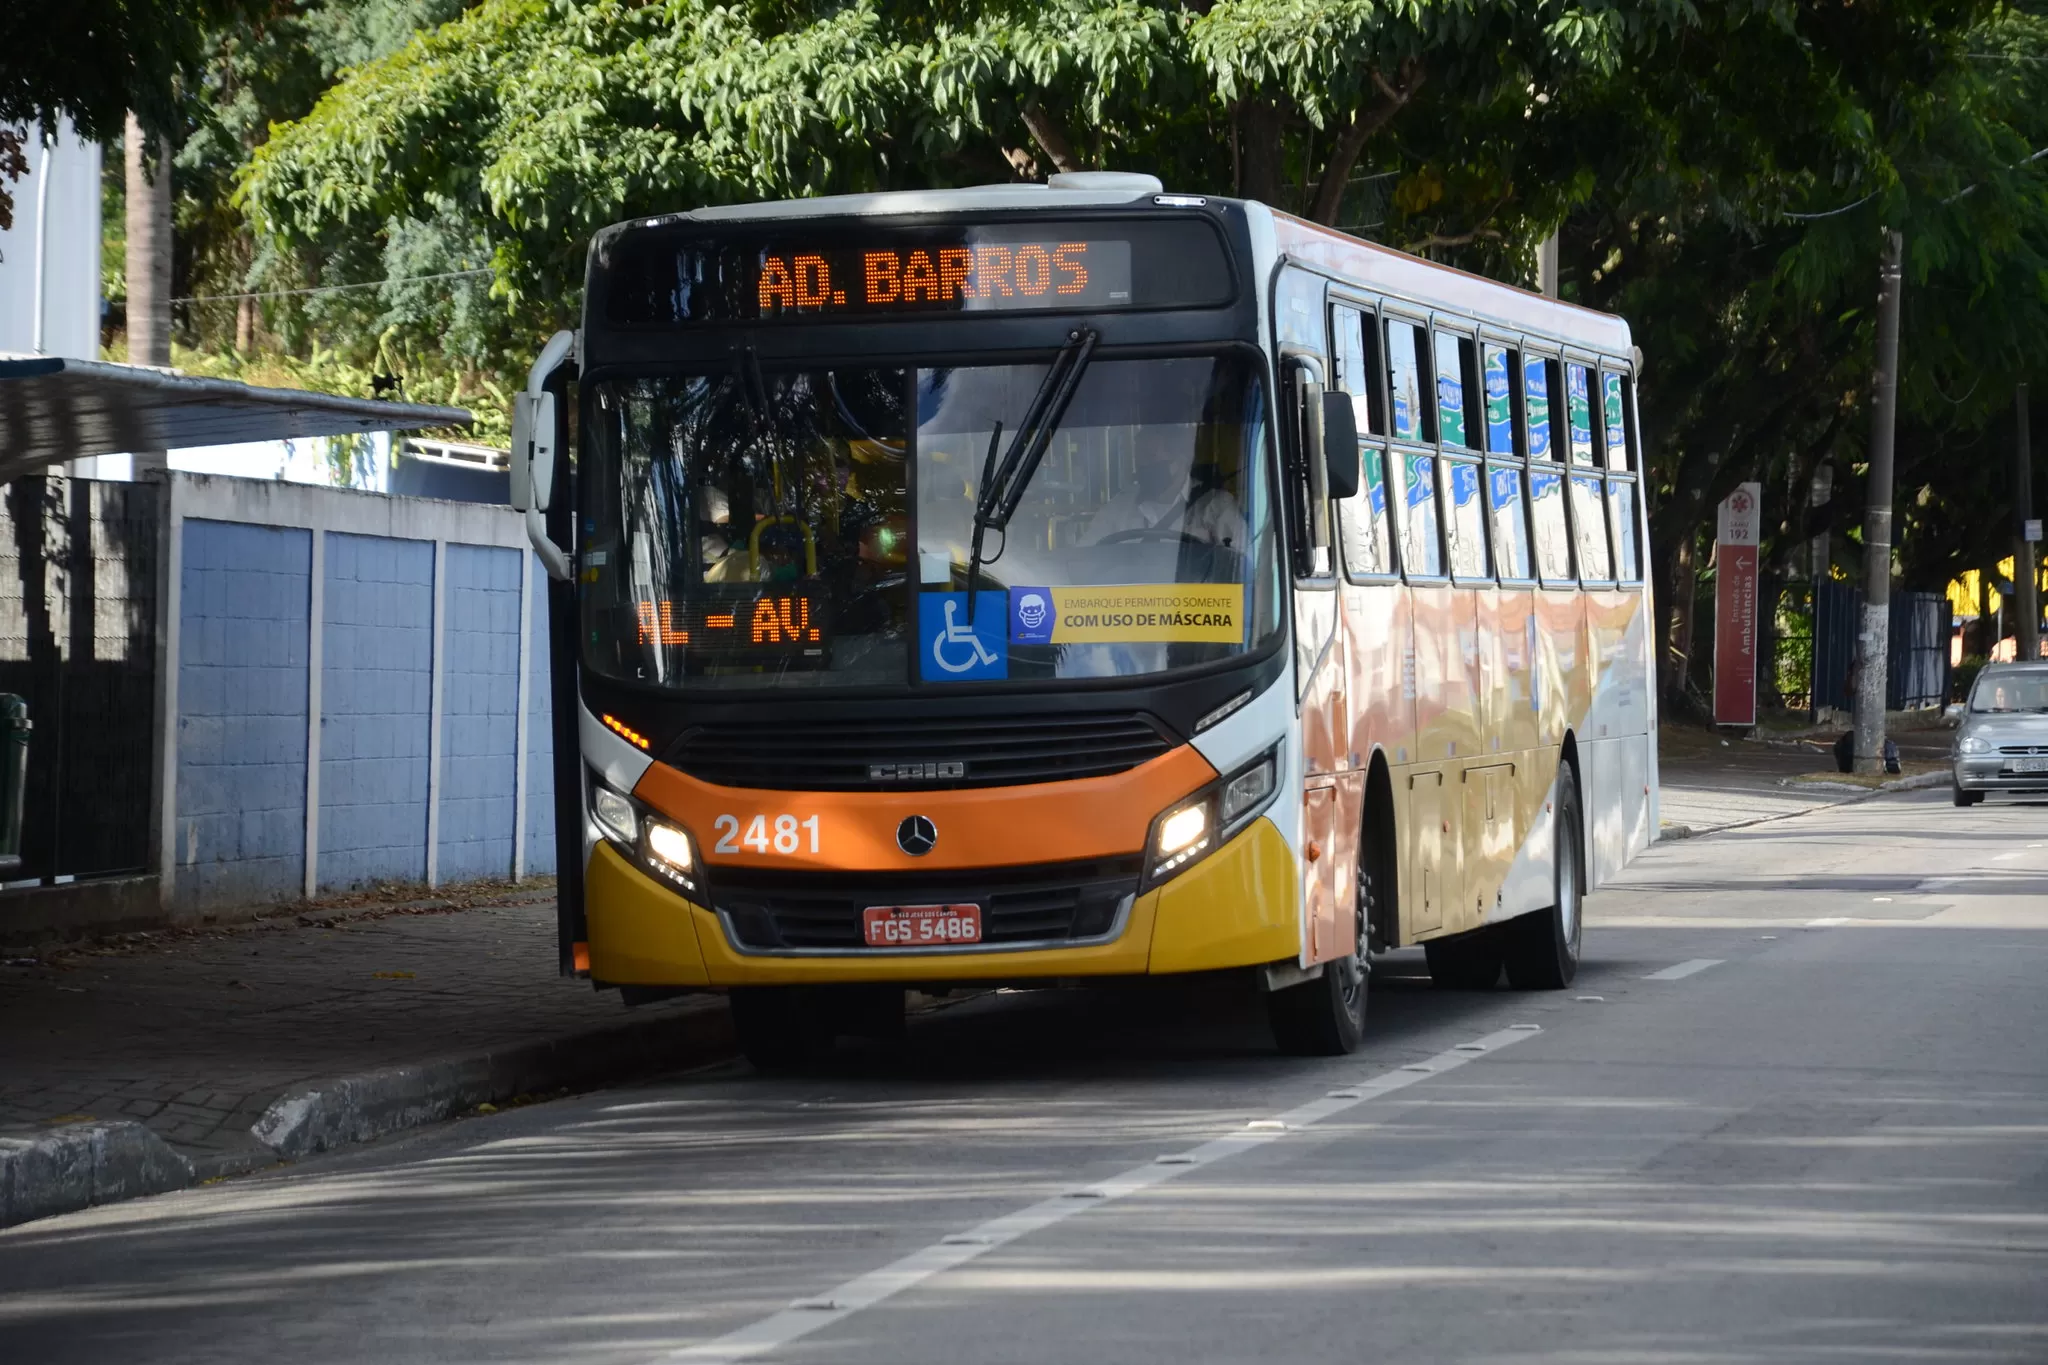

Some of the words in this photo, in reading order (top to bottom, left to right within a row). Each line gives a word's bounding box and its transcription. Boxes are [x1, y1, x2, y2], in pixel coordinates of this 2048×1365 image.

[759, 256, 848, 308] AD.
[864, 242, 1089, 304] BARROS
[1730, 529, 1749, 540] 192
[1064, 597, 1123, 609] EMBARQUE
[1124, 596, 1181, 608] PERMITIDO
[1183, 596, 1232, 608] SOMENTE
[1732, 588, 1740, 623] Entrada
[752, 597, 821, 643] AV.
[1063, 614, 1099, 627] COM
[1101, 614, 1133, 627] USO
[1136, 613, 1156, 626] DE
[1159, 610, 1233, 627] MÁSCARA
[869, 762, 964, 780] CAIO
[714, 814, 820, 854] 2481
[870, 920, 912, 941] FGS
[919, 917, 975, 940] 5486
